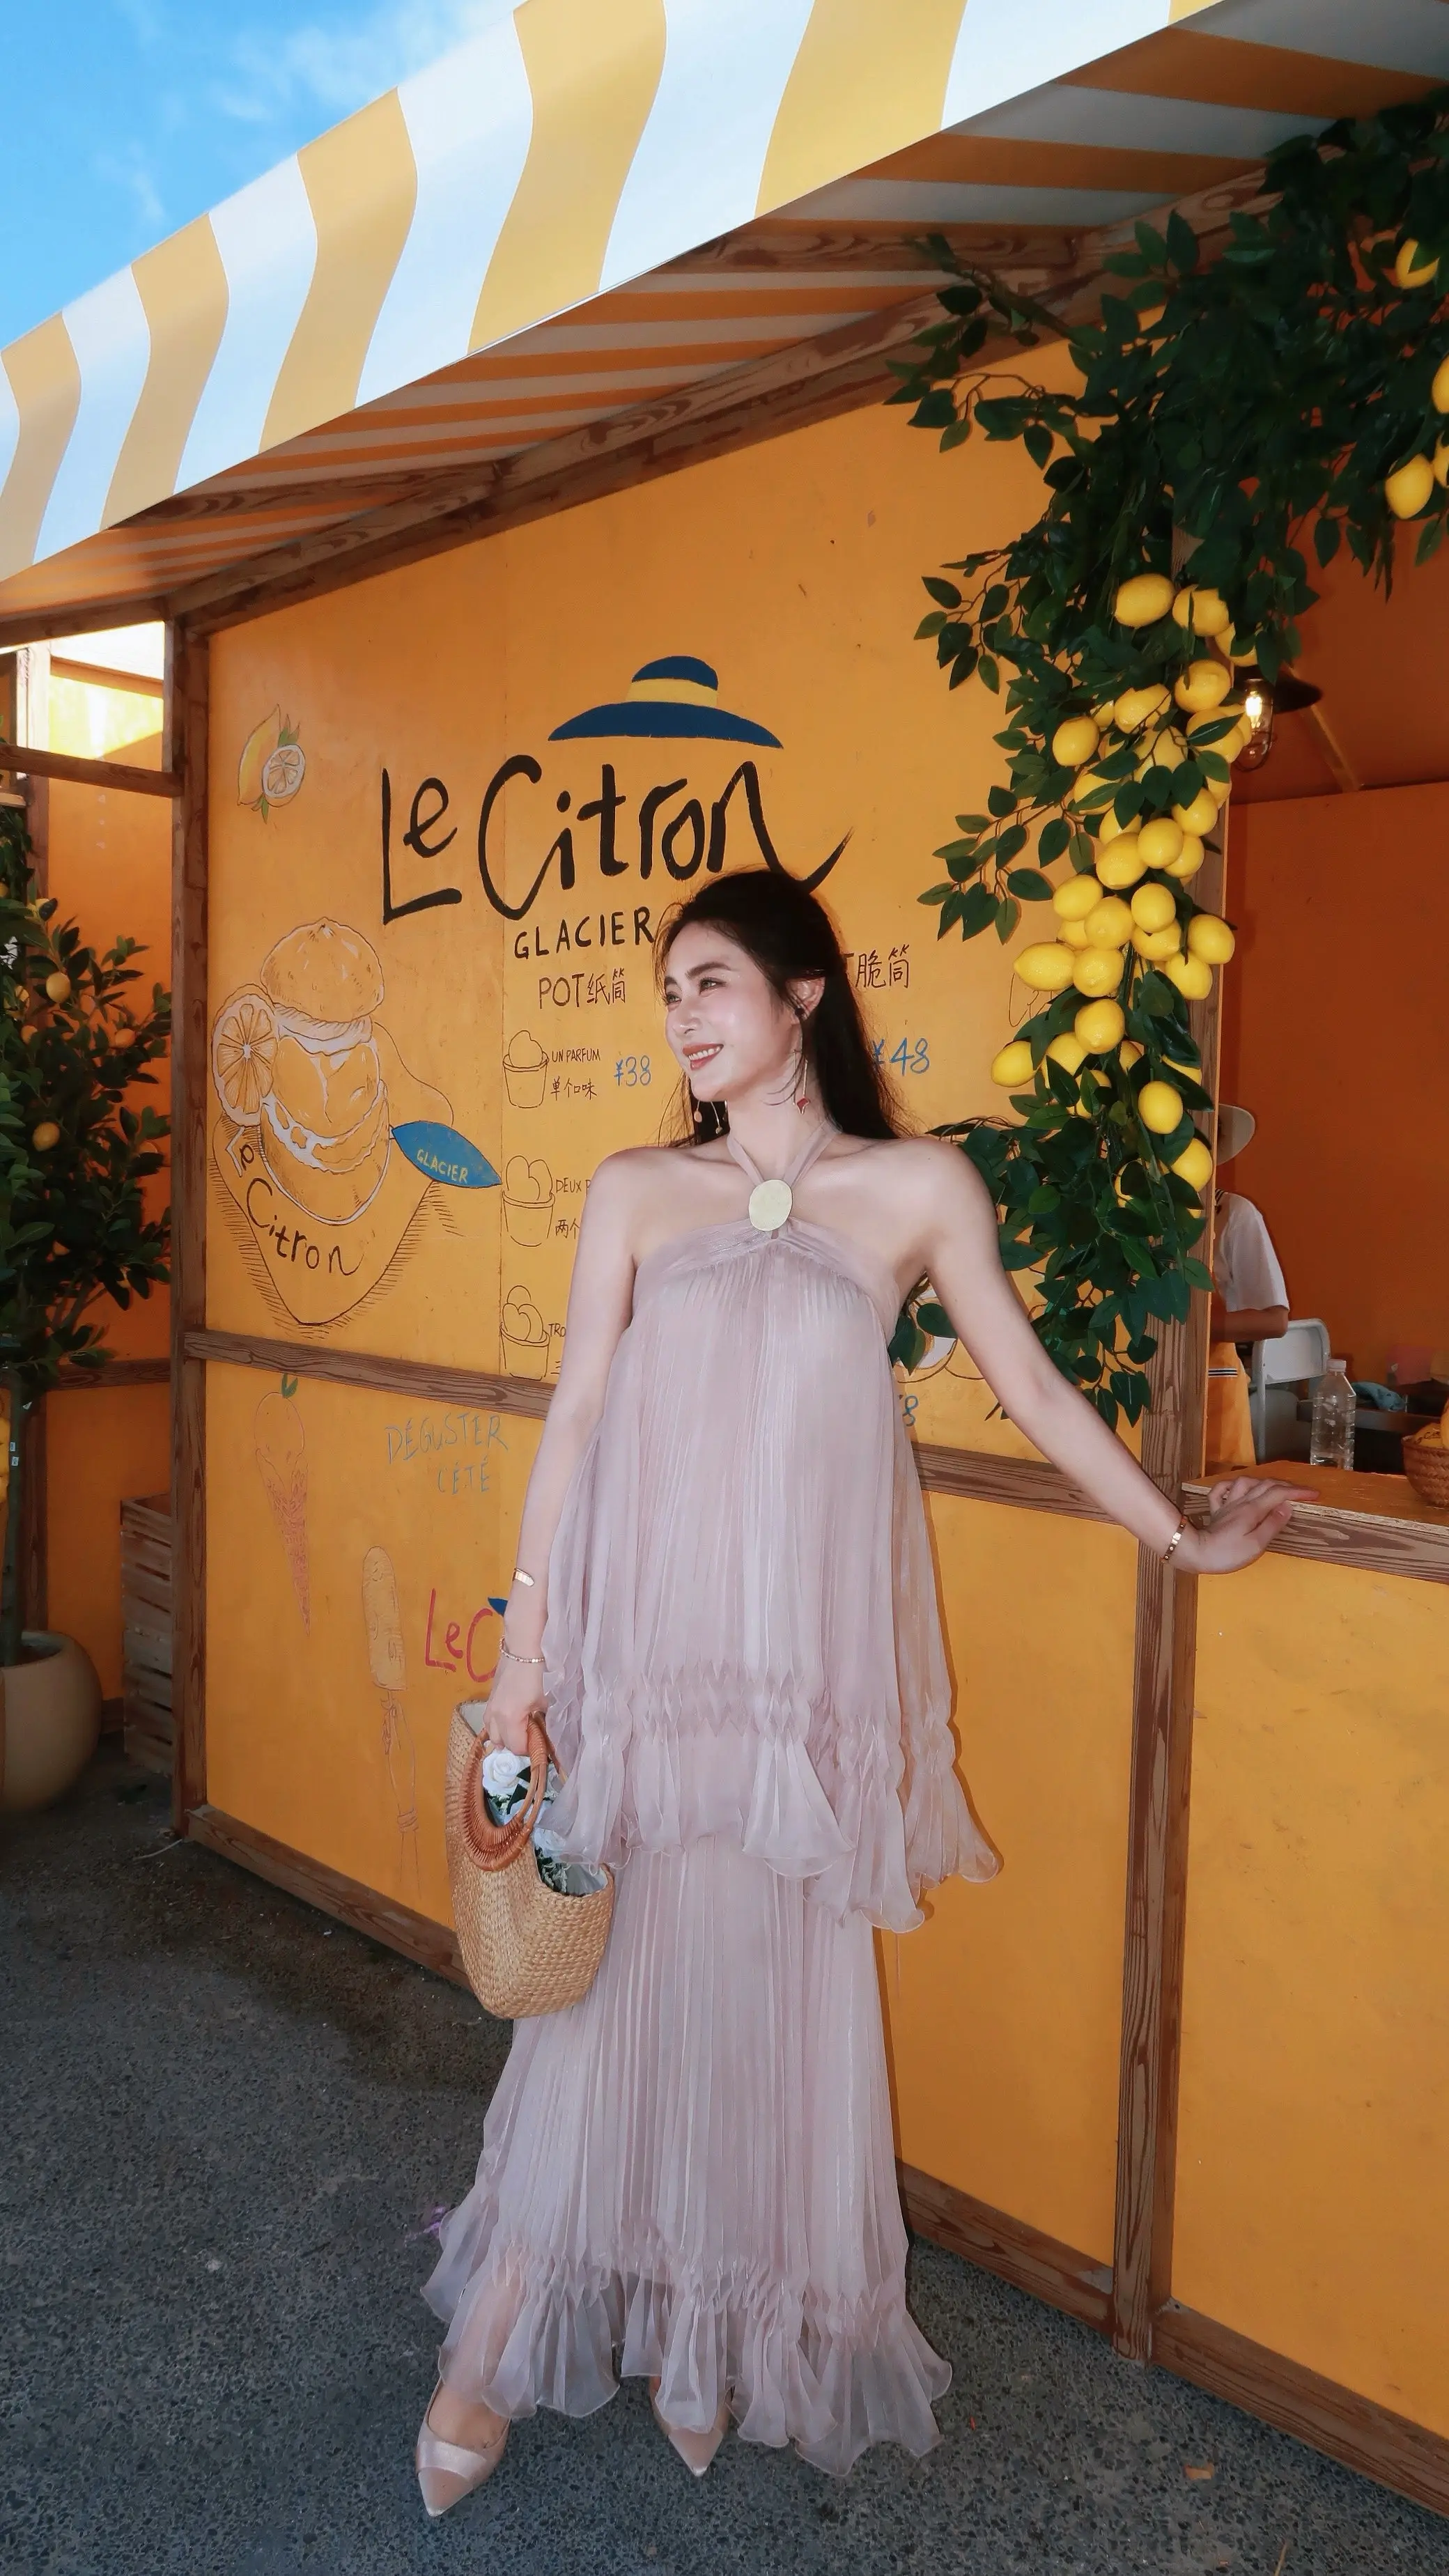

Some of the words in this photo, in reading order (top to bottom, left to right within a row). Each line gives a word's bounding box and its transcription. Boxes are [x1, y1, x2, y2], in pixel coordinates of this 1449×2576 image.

[382, 767, 462, 925] Le
[478, 754, 854, 920] Citron
[513, 906, 656, 959] GLACIER
[551, 1050, 564, 1063] UN
[566, 1048, 601, 1063] PARFUM
[613, 1055, 651, 1087] ¥38
[550, 1075, 598, 1101] 单个口味
[417, 1149, 469, 1184] GLACIER
[555, 1177, 582, 1193] DEUX
[246, 1178, 364, 1275] Citron
[555, 1218, 580, 1239] 两个
[548, 1322, 566, 1337] TRO
